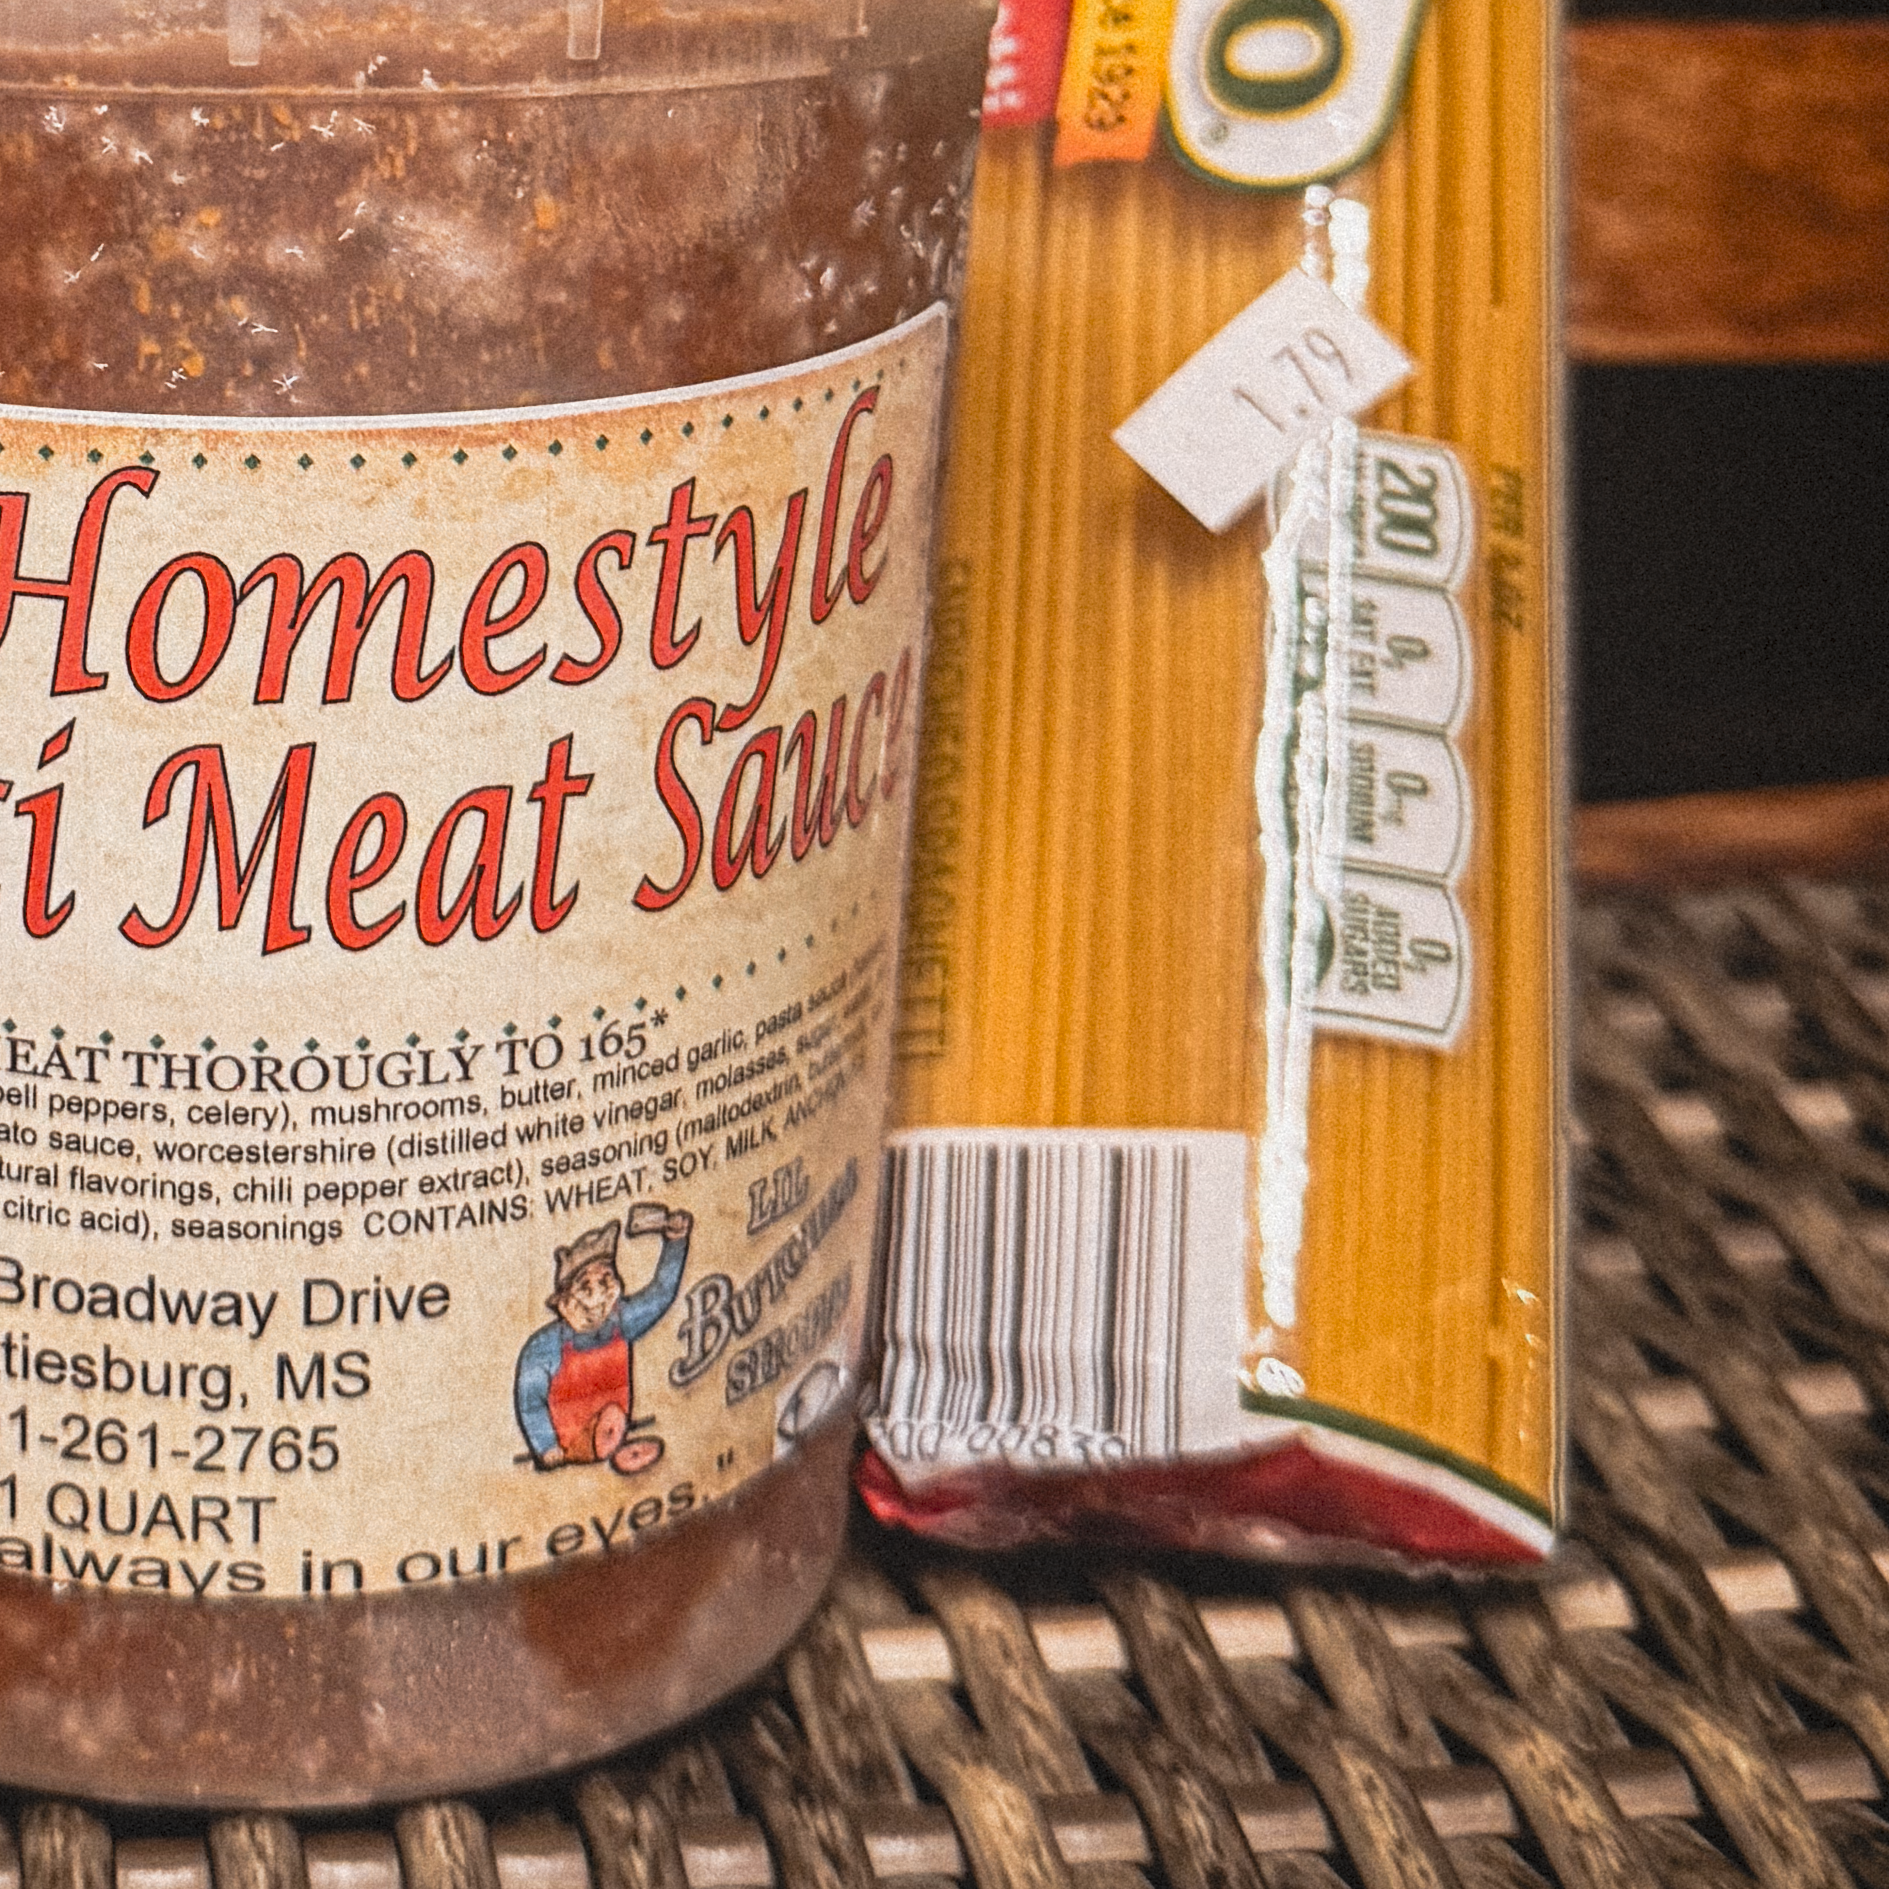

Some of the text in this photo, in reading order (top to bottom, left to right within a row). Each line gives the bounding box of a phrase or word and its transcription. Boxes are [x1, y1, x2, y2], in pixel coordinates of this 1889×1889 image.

[1082, 42, 1138, 135] 1923
[1232, 326, 1355, 436] 1.79
[1374, 457, 1441, 560] 200
[118, 733, 595, 956] Meat
[633, 644, 911, 911] Sauce
[1341, 889, 1372, 998] SUGARS
[1371, 905, 1403, 994] ADDED
[48, 1092, 176, 1128] peppers,
[185, 1098, 298, 1132] celery),
[310, 1092, 489, 1127] mushrooms,
[499, 1075, 582, 1110] butter,
[592, 1048, 681, 1092] minced
[686, 1024, 749, 1075] garlic,
[754, 999, 803, 1047] pasta
[122, 1043, 485, 1094] THOROUGLY
[496, 1031, 564, 1078] TO
[48, 1128, 143, 1163] sauce,
[153, 1133, 376, 1166] worcestershire
[386, 1121, 507, 1167] (distilled
[516, 1113, 585, 1145] white
[594, 1087, 686, 1130] vinegar,
[69, 1165, 222, 1207] flavorings,
[232, 1176, 293, 1205] chili
[303, 1175, 409, 1208] pepper
[418, 1158, 531, 1197] extract),
[539, 1126, 670, 1177] seasoning
[3, 1195, 72, 1228] citric
[79, 1209, 160, 1241] acid),
[170, 1216, 344, 1246] seasonings
[362, 1192, 535, 1239] CONTAINS:
[544, 1169, 654, 1215] WHEAT,
[661, 1148, 718, 1186] SOY,
[302, 1275, 452, 1328] Drive
[276, 1350, 372, 1402] MS
[46, 1481, 278, 1544] QUART
[301, 1548, 363, 1594] in
[395, 1532, 522, 1585] our
